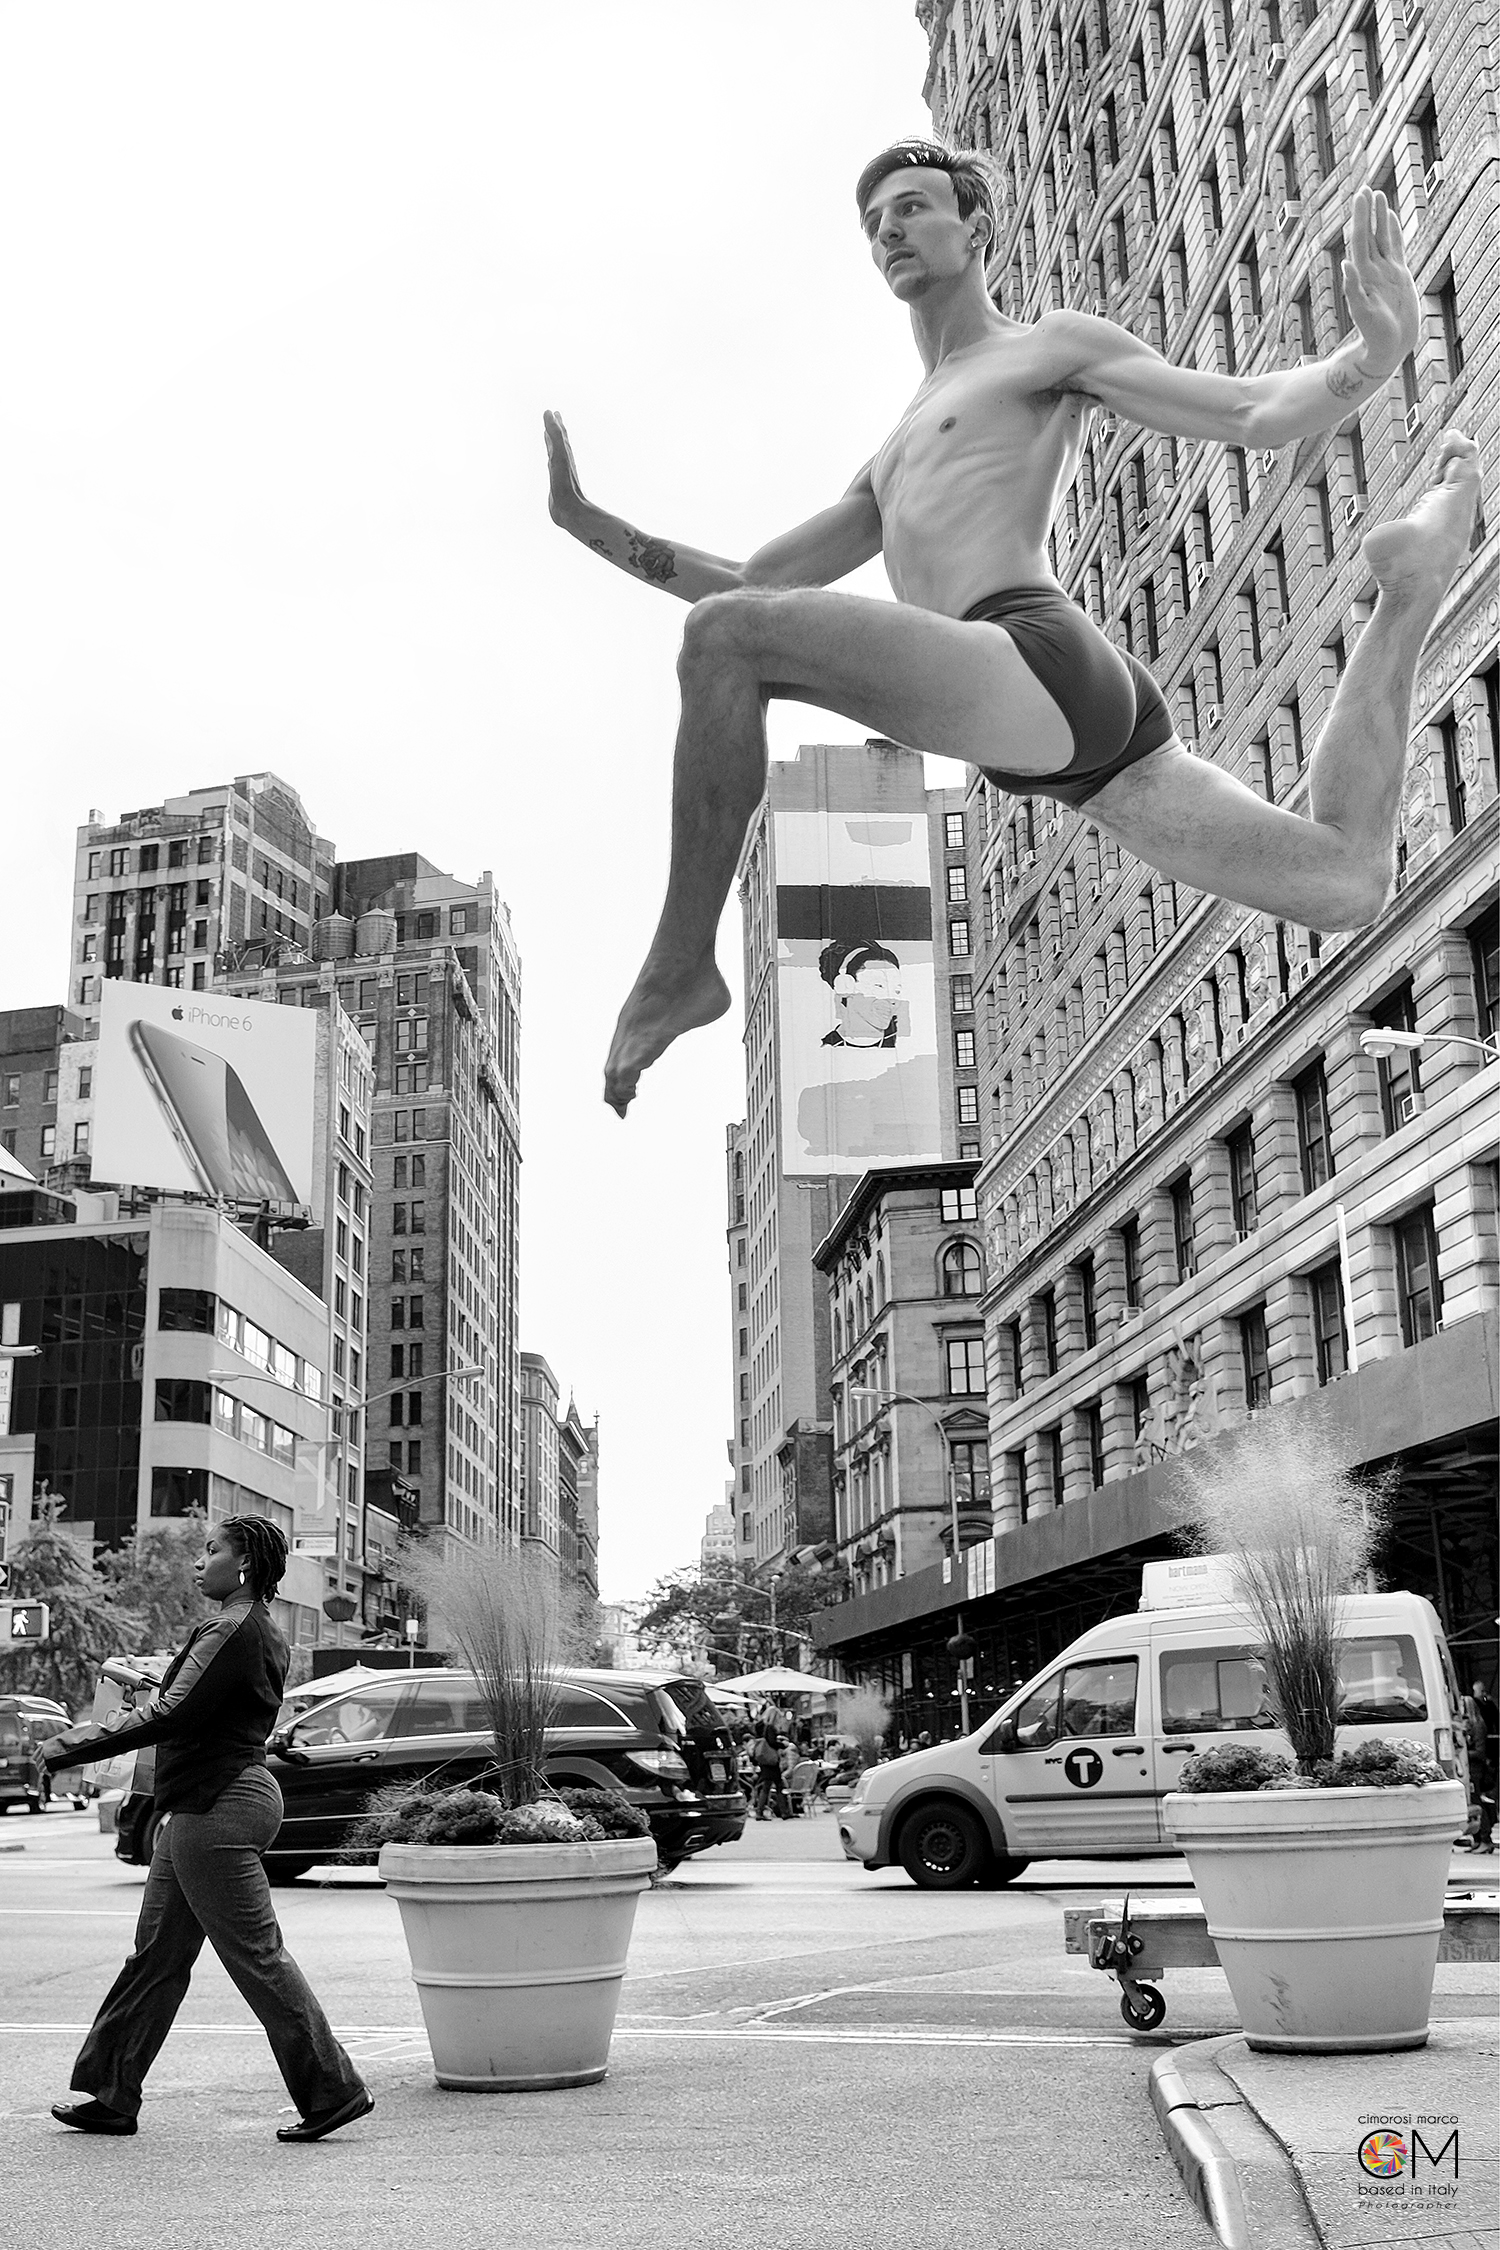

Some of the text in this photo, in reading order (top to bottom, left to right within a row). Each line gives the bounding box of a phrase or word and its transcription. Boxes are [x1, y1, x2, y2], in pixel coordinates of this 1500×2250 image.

[188, 1006, 253, 1032] iPhone 6
[1045, 1755, 1095, 1784] NYC T
